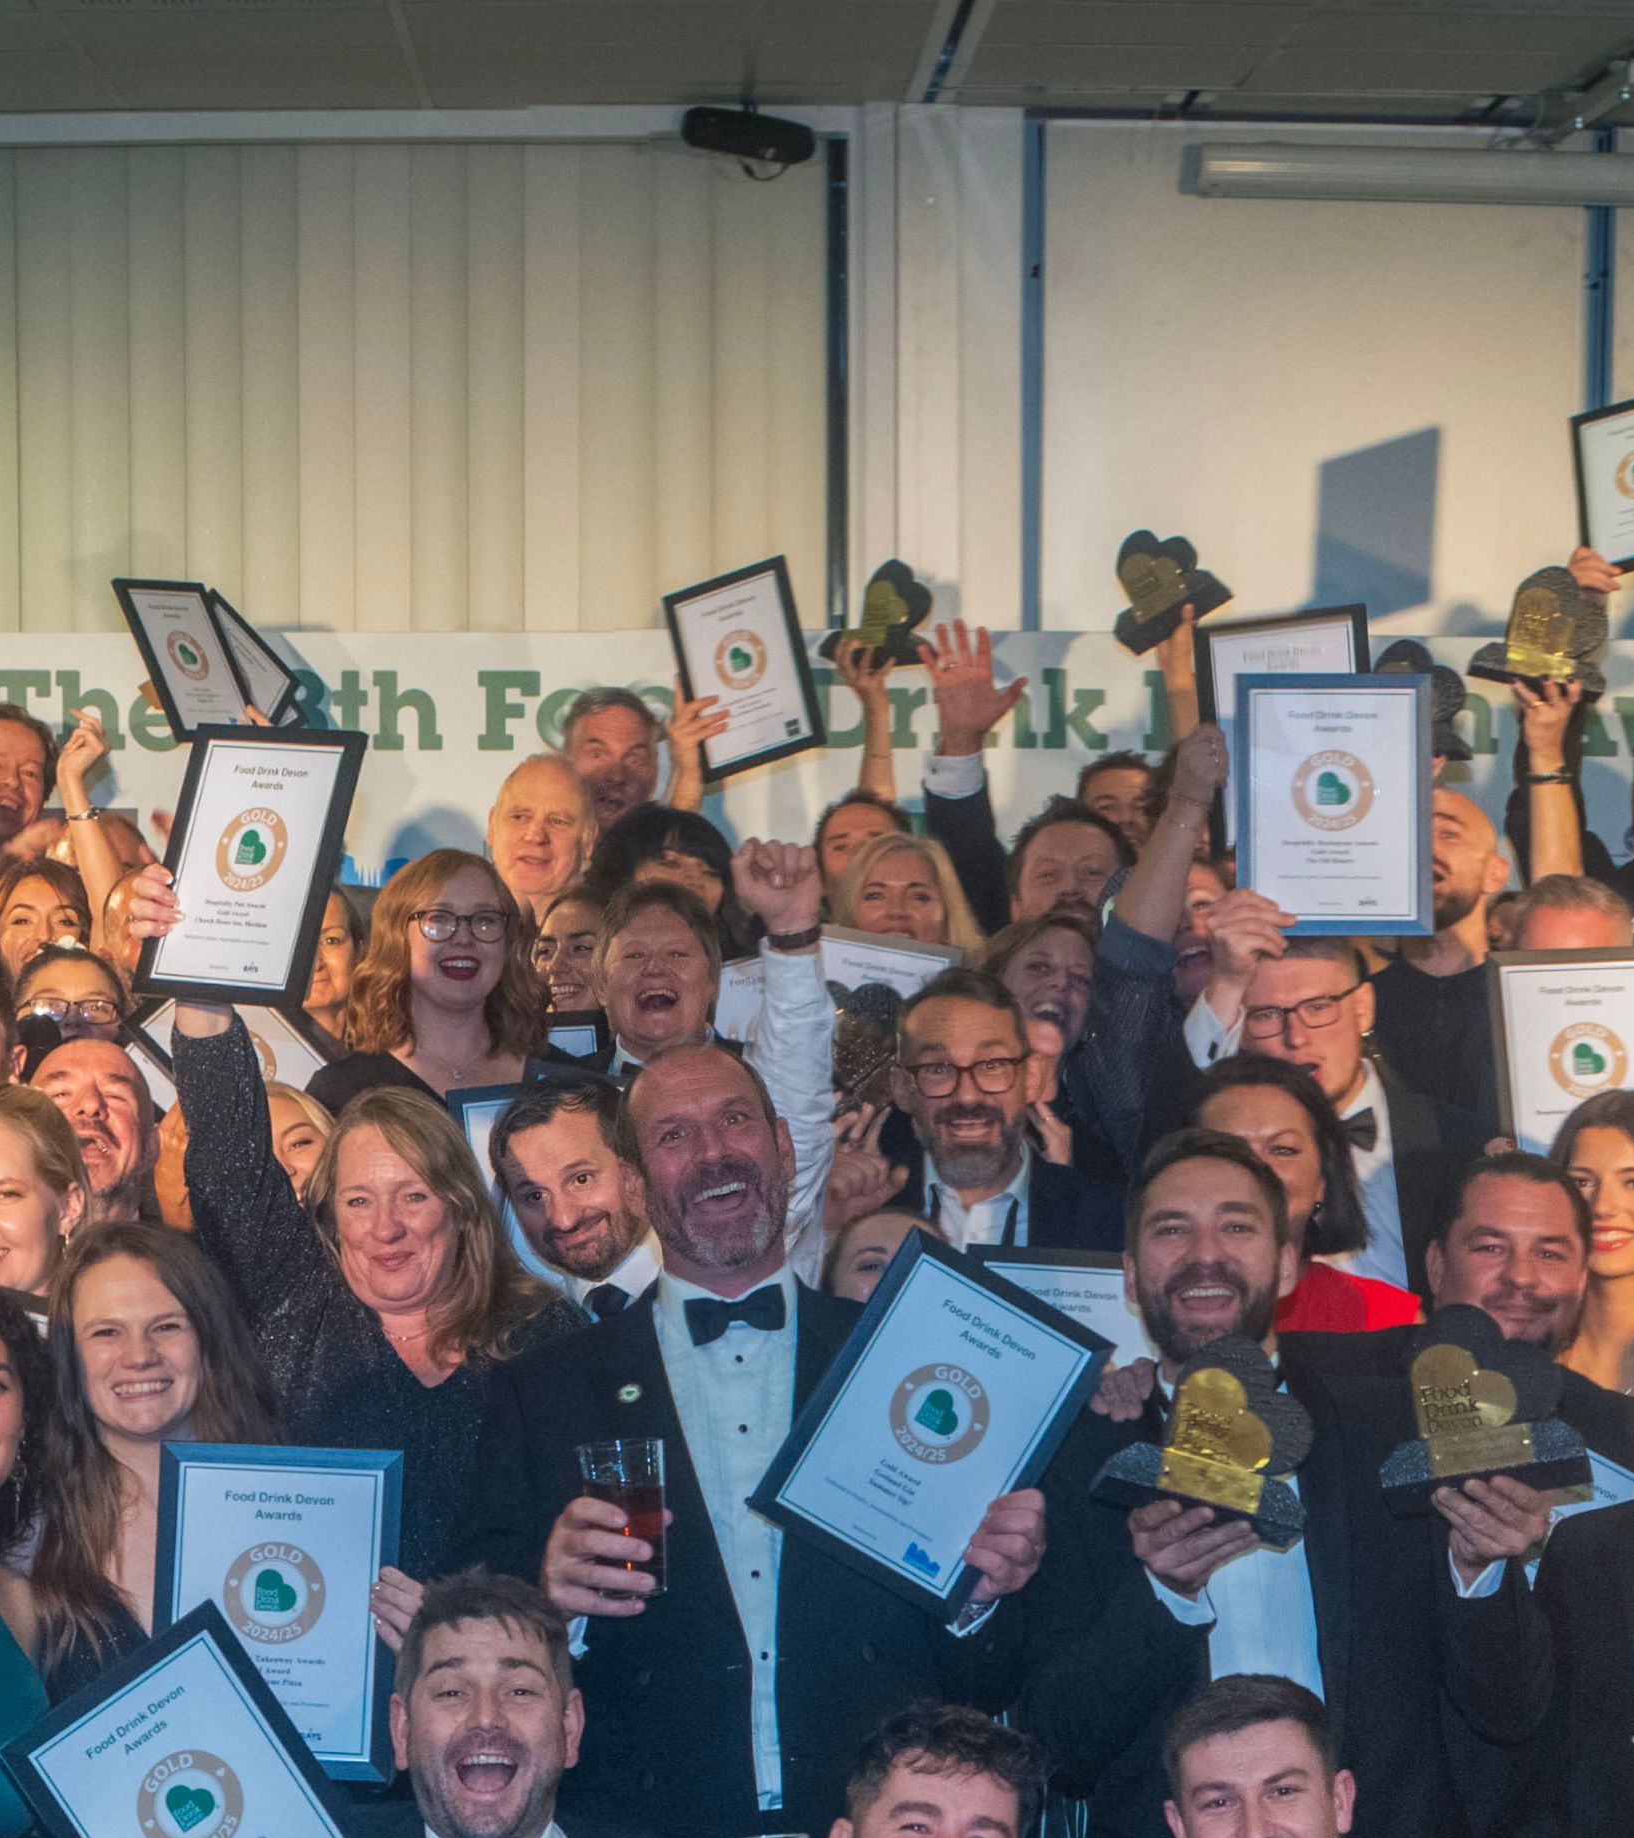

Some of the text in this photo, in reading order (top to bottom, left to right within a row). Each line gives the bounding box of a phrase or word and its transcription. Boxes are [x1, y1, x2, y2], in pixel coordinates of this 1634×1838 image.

[225, 1490, 334, 1506] Food Drink Devon
[254, 1509, 302, 1521] Awards
[249, 1543, 304, 1566] GOLD
[241, 1620, 302, 1643] 2024/25
[84, 1682, 185, 1760] Food Drink Devon
[121, 1717, 168, 1756] Awards
[144, 1754, 194, 1794] GOLD
